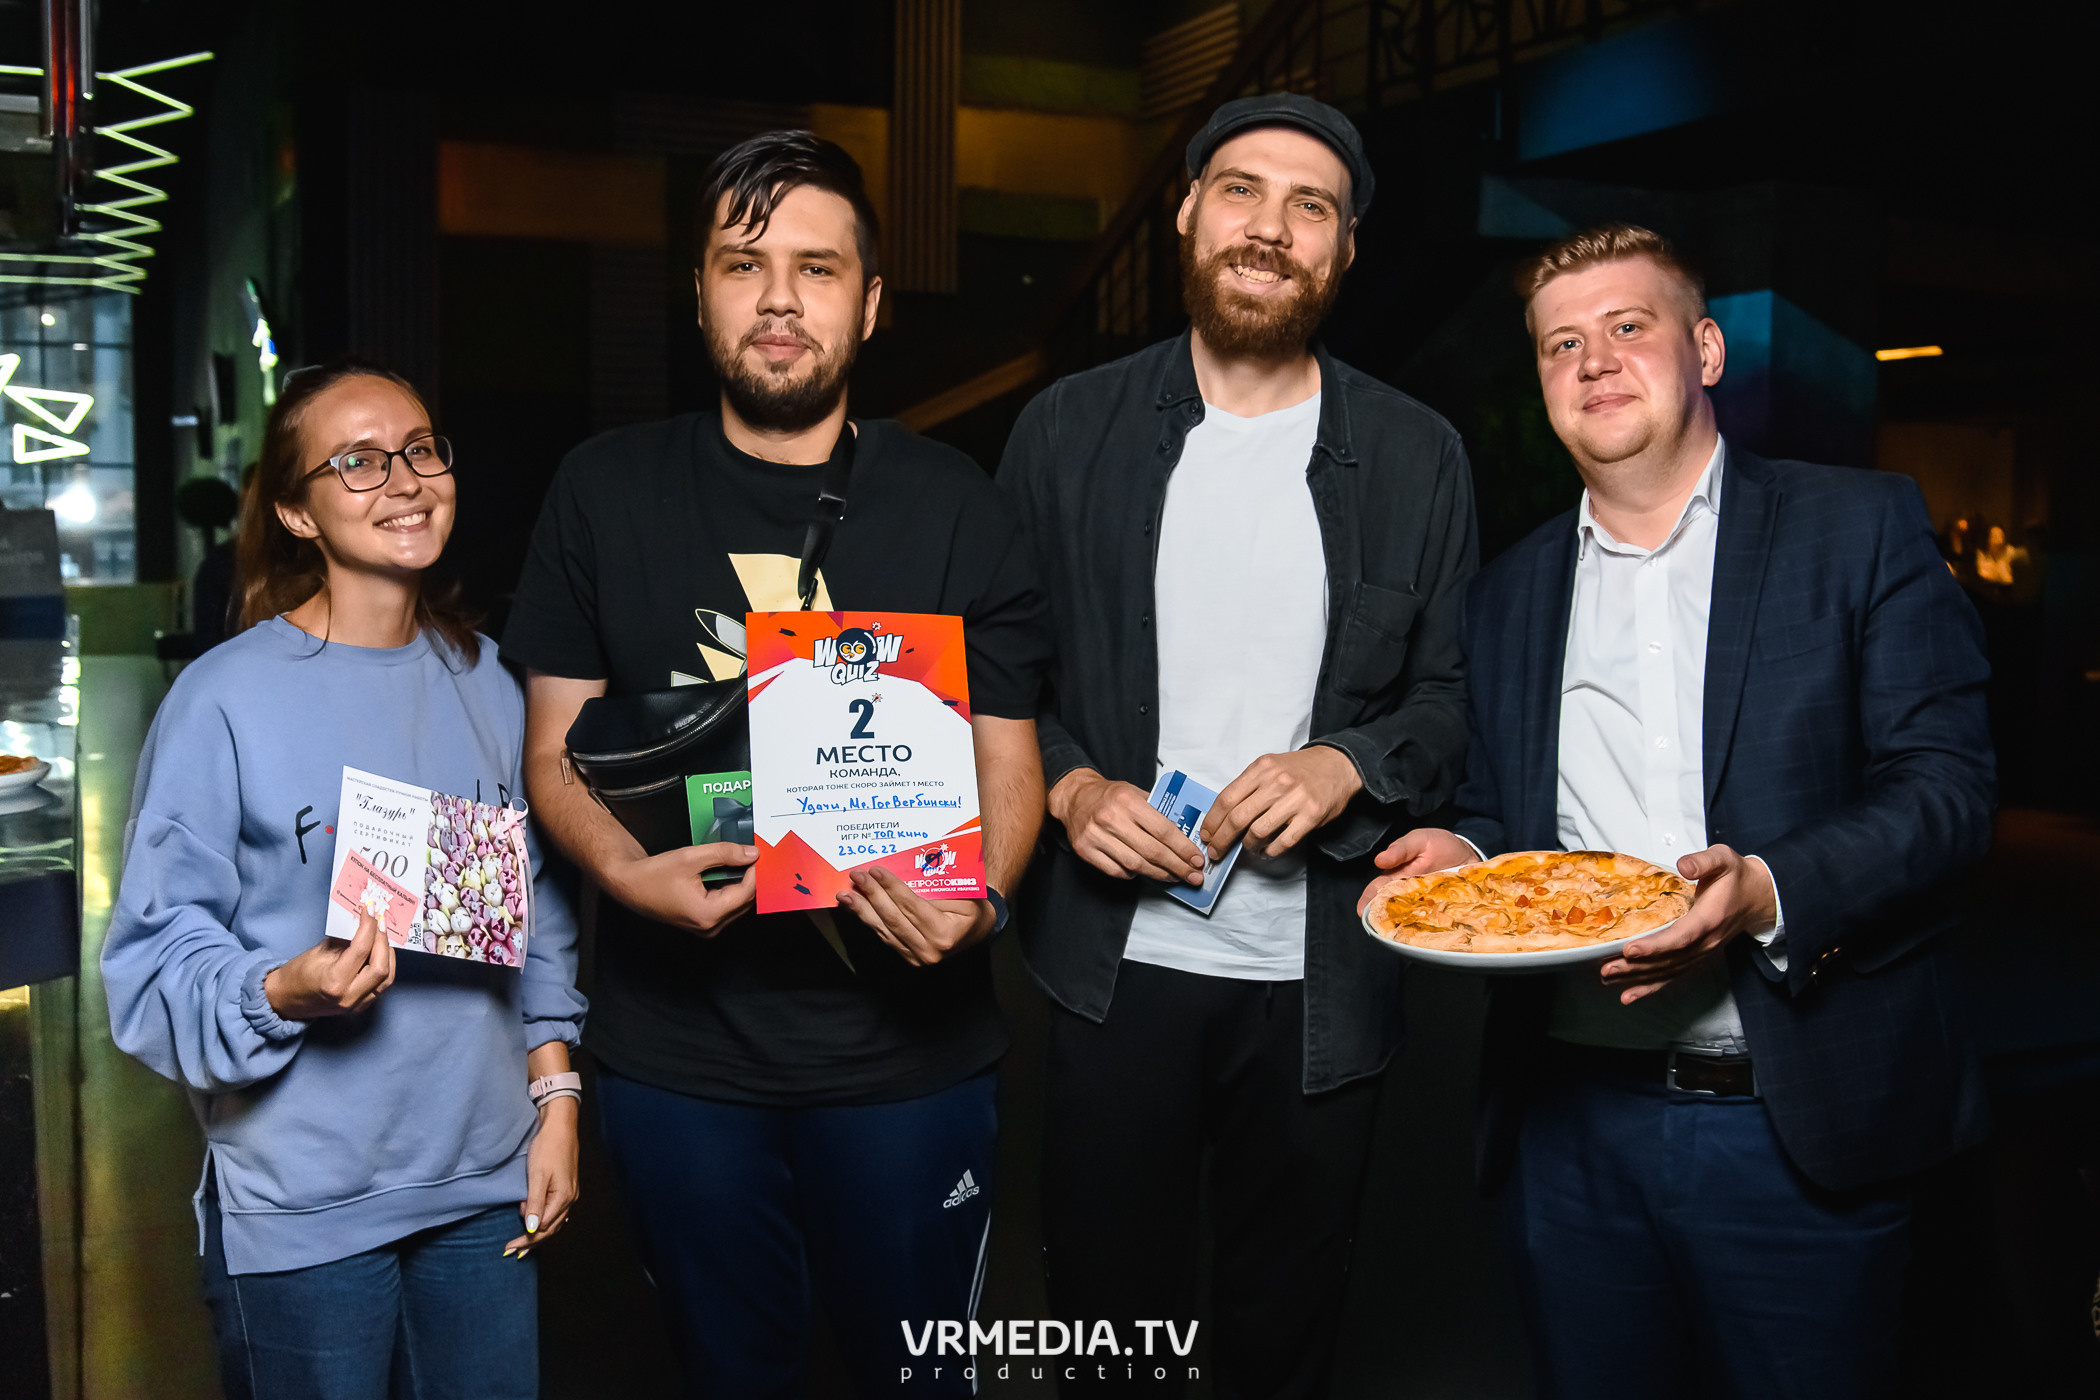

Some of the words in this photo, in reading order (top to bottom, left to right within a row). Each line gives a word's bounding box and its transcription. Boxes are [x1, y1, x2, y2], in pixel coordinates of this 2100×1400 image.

[830, 660, 880, 686] QUIZ
[848, 698, 875, 740] 2
[816, 744, 913, 765] МЕСТО
[829, 767, 901, 779] КОМАНДА,
[702, 780, 751, 794] ПОДАР
[786, 784, 824, 793] КОТОРАЯ
[796, 796, 847, 815] Удачи,
[353, 821, 414, 840] ПОДАРОЧНЫЙ
[836, 822, 900, 832] ПОБЕДИТЕЛИ
[353, 829, 412, 847] СЕРТИФИКАТ
[841, 833, 859, 841] ИГР
